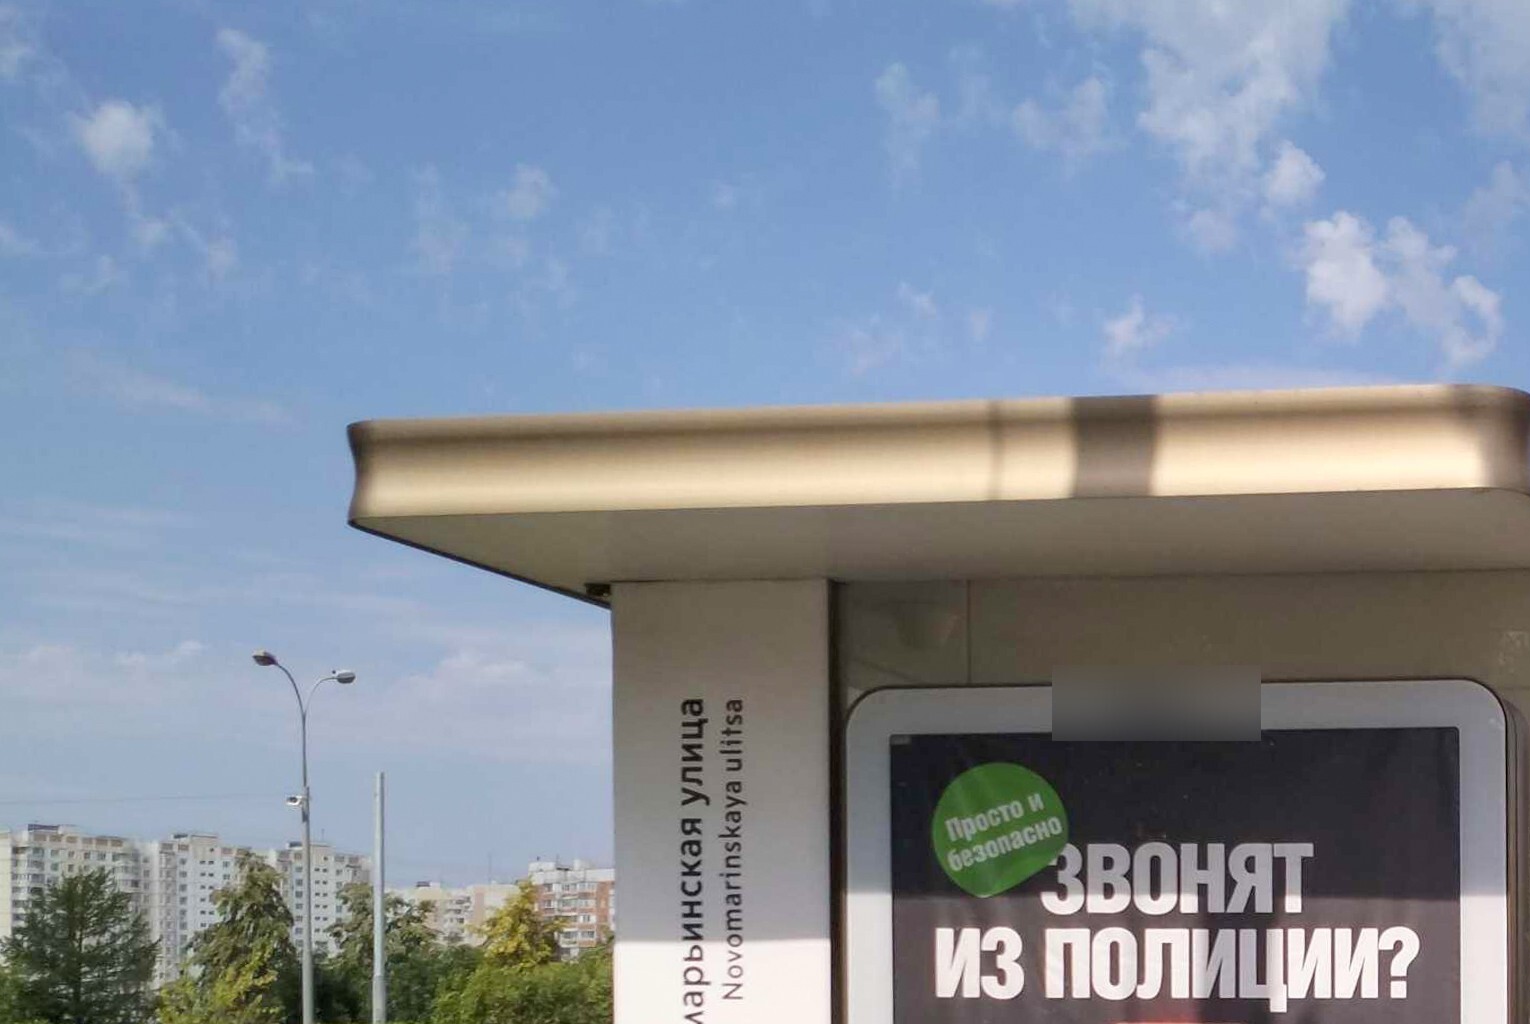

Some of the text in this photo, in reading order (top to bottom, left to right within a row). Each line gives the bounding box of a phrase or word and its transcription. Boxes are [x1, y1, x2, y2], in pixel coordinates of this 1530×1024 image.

[680, 699, 710, 806] улица
[718, 699, 748, 1000] Novomarinskaya ulitsa
[945, 793, 1044, 841] Просто и
[947, 817, 1062, 871] безопасно
[1040, 842, 1314, 915] ЗВОНЯТ
[935, 926, 1420, 1013] ИЗ ПОЛИЦИИ?
